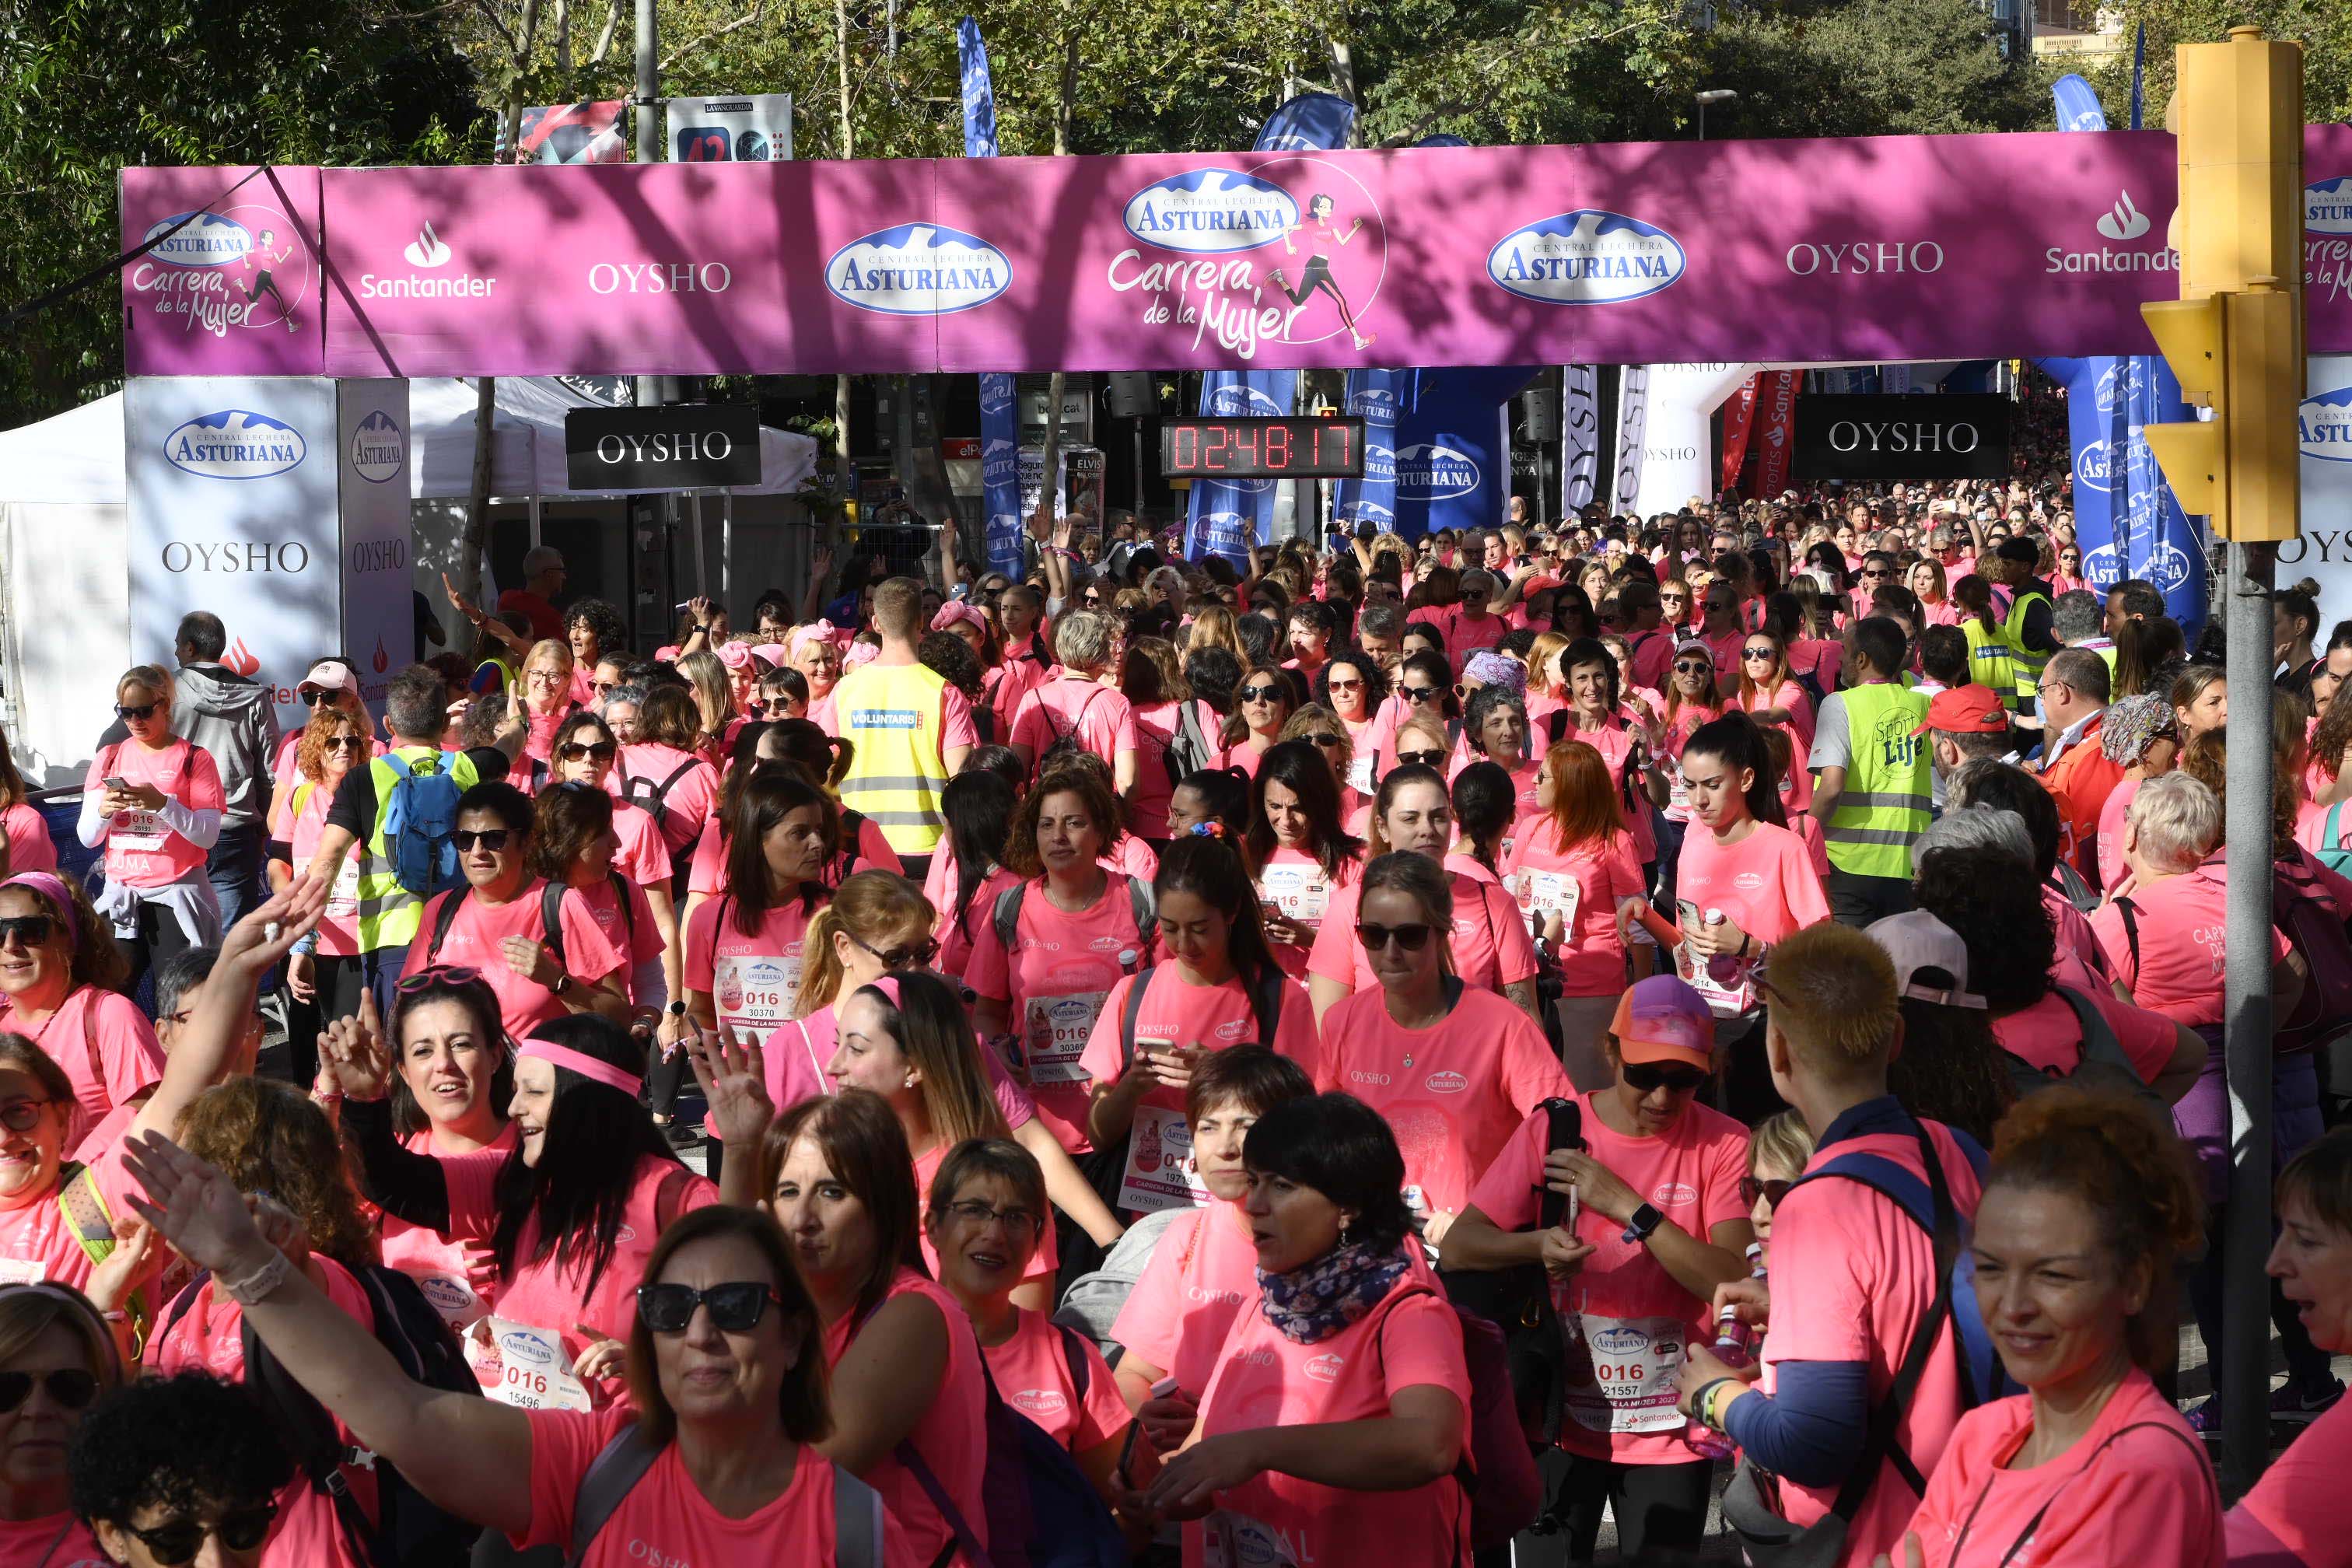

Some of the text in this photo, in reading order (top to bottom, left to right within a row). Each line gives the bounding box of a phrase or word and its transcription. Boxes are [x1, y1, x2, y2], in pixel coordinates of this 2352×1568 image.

[1136, 200, 1286, 232] ASTURIANA
[1533, 242, 1664, 253] CENTRAL LECHERA
[1786, 241, 1944, 275] OYSHO
[1108, 248, 1253, 292] Carrera
[1503, 247, 1671, 281] ASTURIANA
[2046, 247, 2181, 273] Santande
[133, 262, 224, 292] Carrera
[360, 274, 496, 299] Santander
[589, 262, 731, 293] OYSHO
[840, 257, 999, 292] ASTURIANA
[156, 291, 259, 337] de la Mujer
[1143, 286, 1307, 359] de la Mujer
[1770, 369, 1793, 423] Santa
[176, 436, 296, 462] ASTURIANA
[197, 432, 291, 442] CENTRAL LECHERA
[597, 431, 731, 464] OYSHO
[1174, 425, 1349, 469] 02:48:17
[1829, 421, 1979, 453] OYSHO
[355, 438, 401, 466] ASTURIANA
[1077, 459, 1101, 469] ELVIS
[1642, 446, 1696, 461] YSHO
[1395, 471, 1472, 487] STURIANA
[161, 541, 309, 572] OYSHO
[353, 538, 404, 573] OYSHO
[1876, 714, 1916, 742] Sport
[1884, 734, 1923, 767] Life
[132, 814, 154, 824] 016
[1533, 895, 1554, 908] 016
[718, 944, 753, 956] OYSHO
[1023, 938, 1060, 951] OYSHO
[746, 992, 779, 1006] 016
[748, 1009, 775, 1018] 30370
[1055, 1027, 1088, 1041] 016
[1136, 1024, 1179, 1036] OYSHO
[1350, 1070, 1466, 1088] OYSHO ASTURIANA
[1136, 1181, 1165, 1192] CARRERA
[1165, 1172, 1192, 1185] 19719
[1129, 1193, 1164, 1207] OYSHO
[505, 1336, 551, 1360] ASTURIANA
[1597, 1335, 1647, 1349] ASTURIANA
[507, 1366, 548, 1394] 016
[1598, 1363, 1644, 1381] 016
[1603, 1385, 1639, 1396] 21557
[1630, 1398, 1656, 1408] MUJER
[1658, 1396, 1675, 1405] 2023
[1639, 1412, 1680, 1423] Santander
